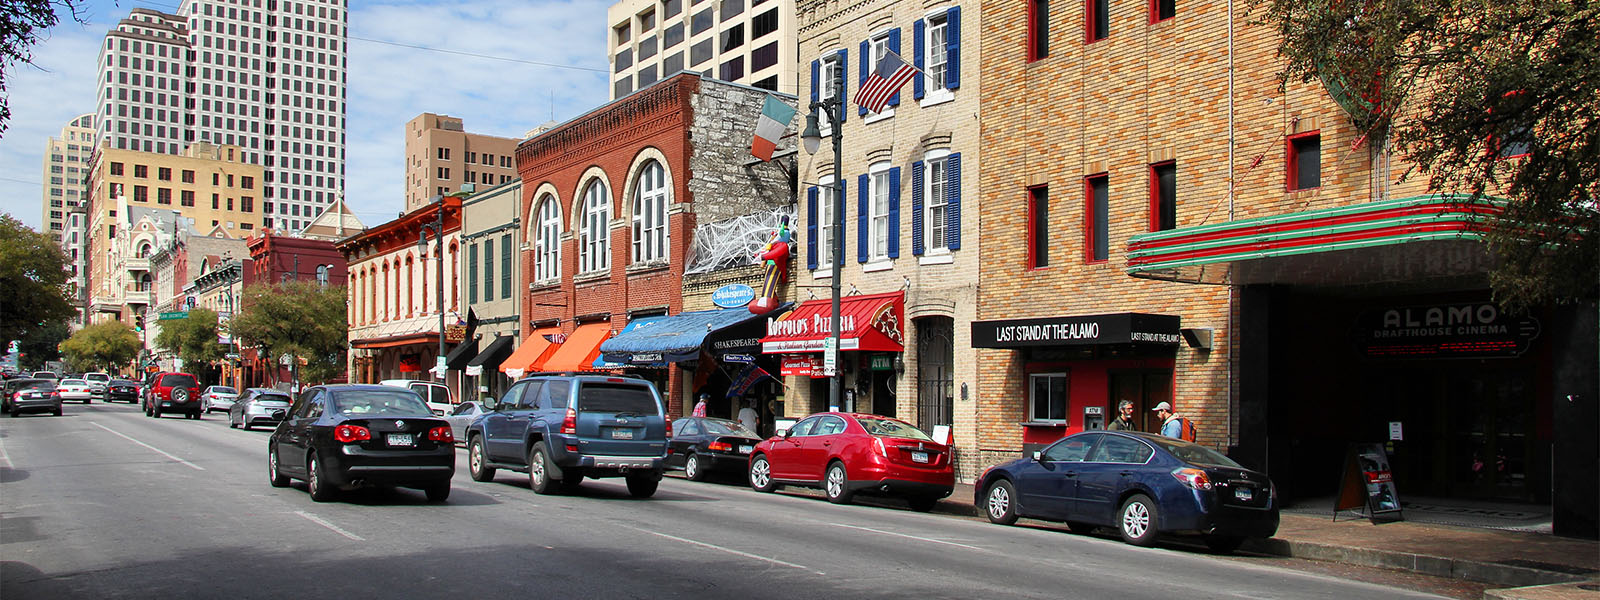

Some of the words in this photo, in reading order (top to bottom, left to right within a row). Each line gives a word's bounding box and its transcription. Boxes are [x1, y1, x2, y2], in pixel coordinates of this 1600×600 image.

[1383, 304, 1497, 328] ALAMO
[767, 316, 808, 337] ROPPOLO'S
[813, 313, 854, 333] PIZZRIA
[996, 327, 1015, 342] LAST
[1016, 325, 1041, 341] STAND
[1041, 324, 1051, 340] AT
[1052, 323, 1069, 339] THE
[1069, 322, 1099, 339] ALAMO
[1373, 327, 1452, 338] DRAFTHOUSE
[1457, 325, 1508, 335] CINEMA
[1130, 332, 1141, 340] LAST
[1141, 332, 1154, 341] STAND
[1159, 333, 1167, 342] THE
[1167, 334, 1180, 342] ALAMO
[872, 357, 890, 368] ATM
